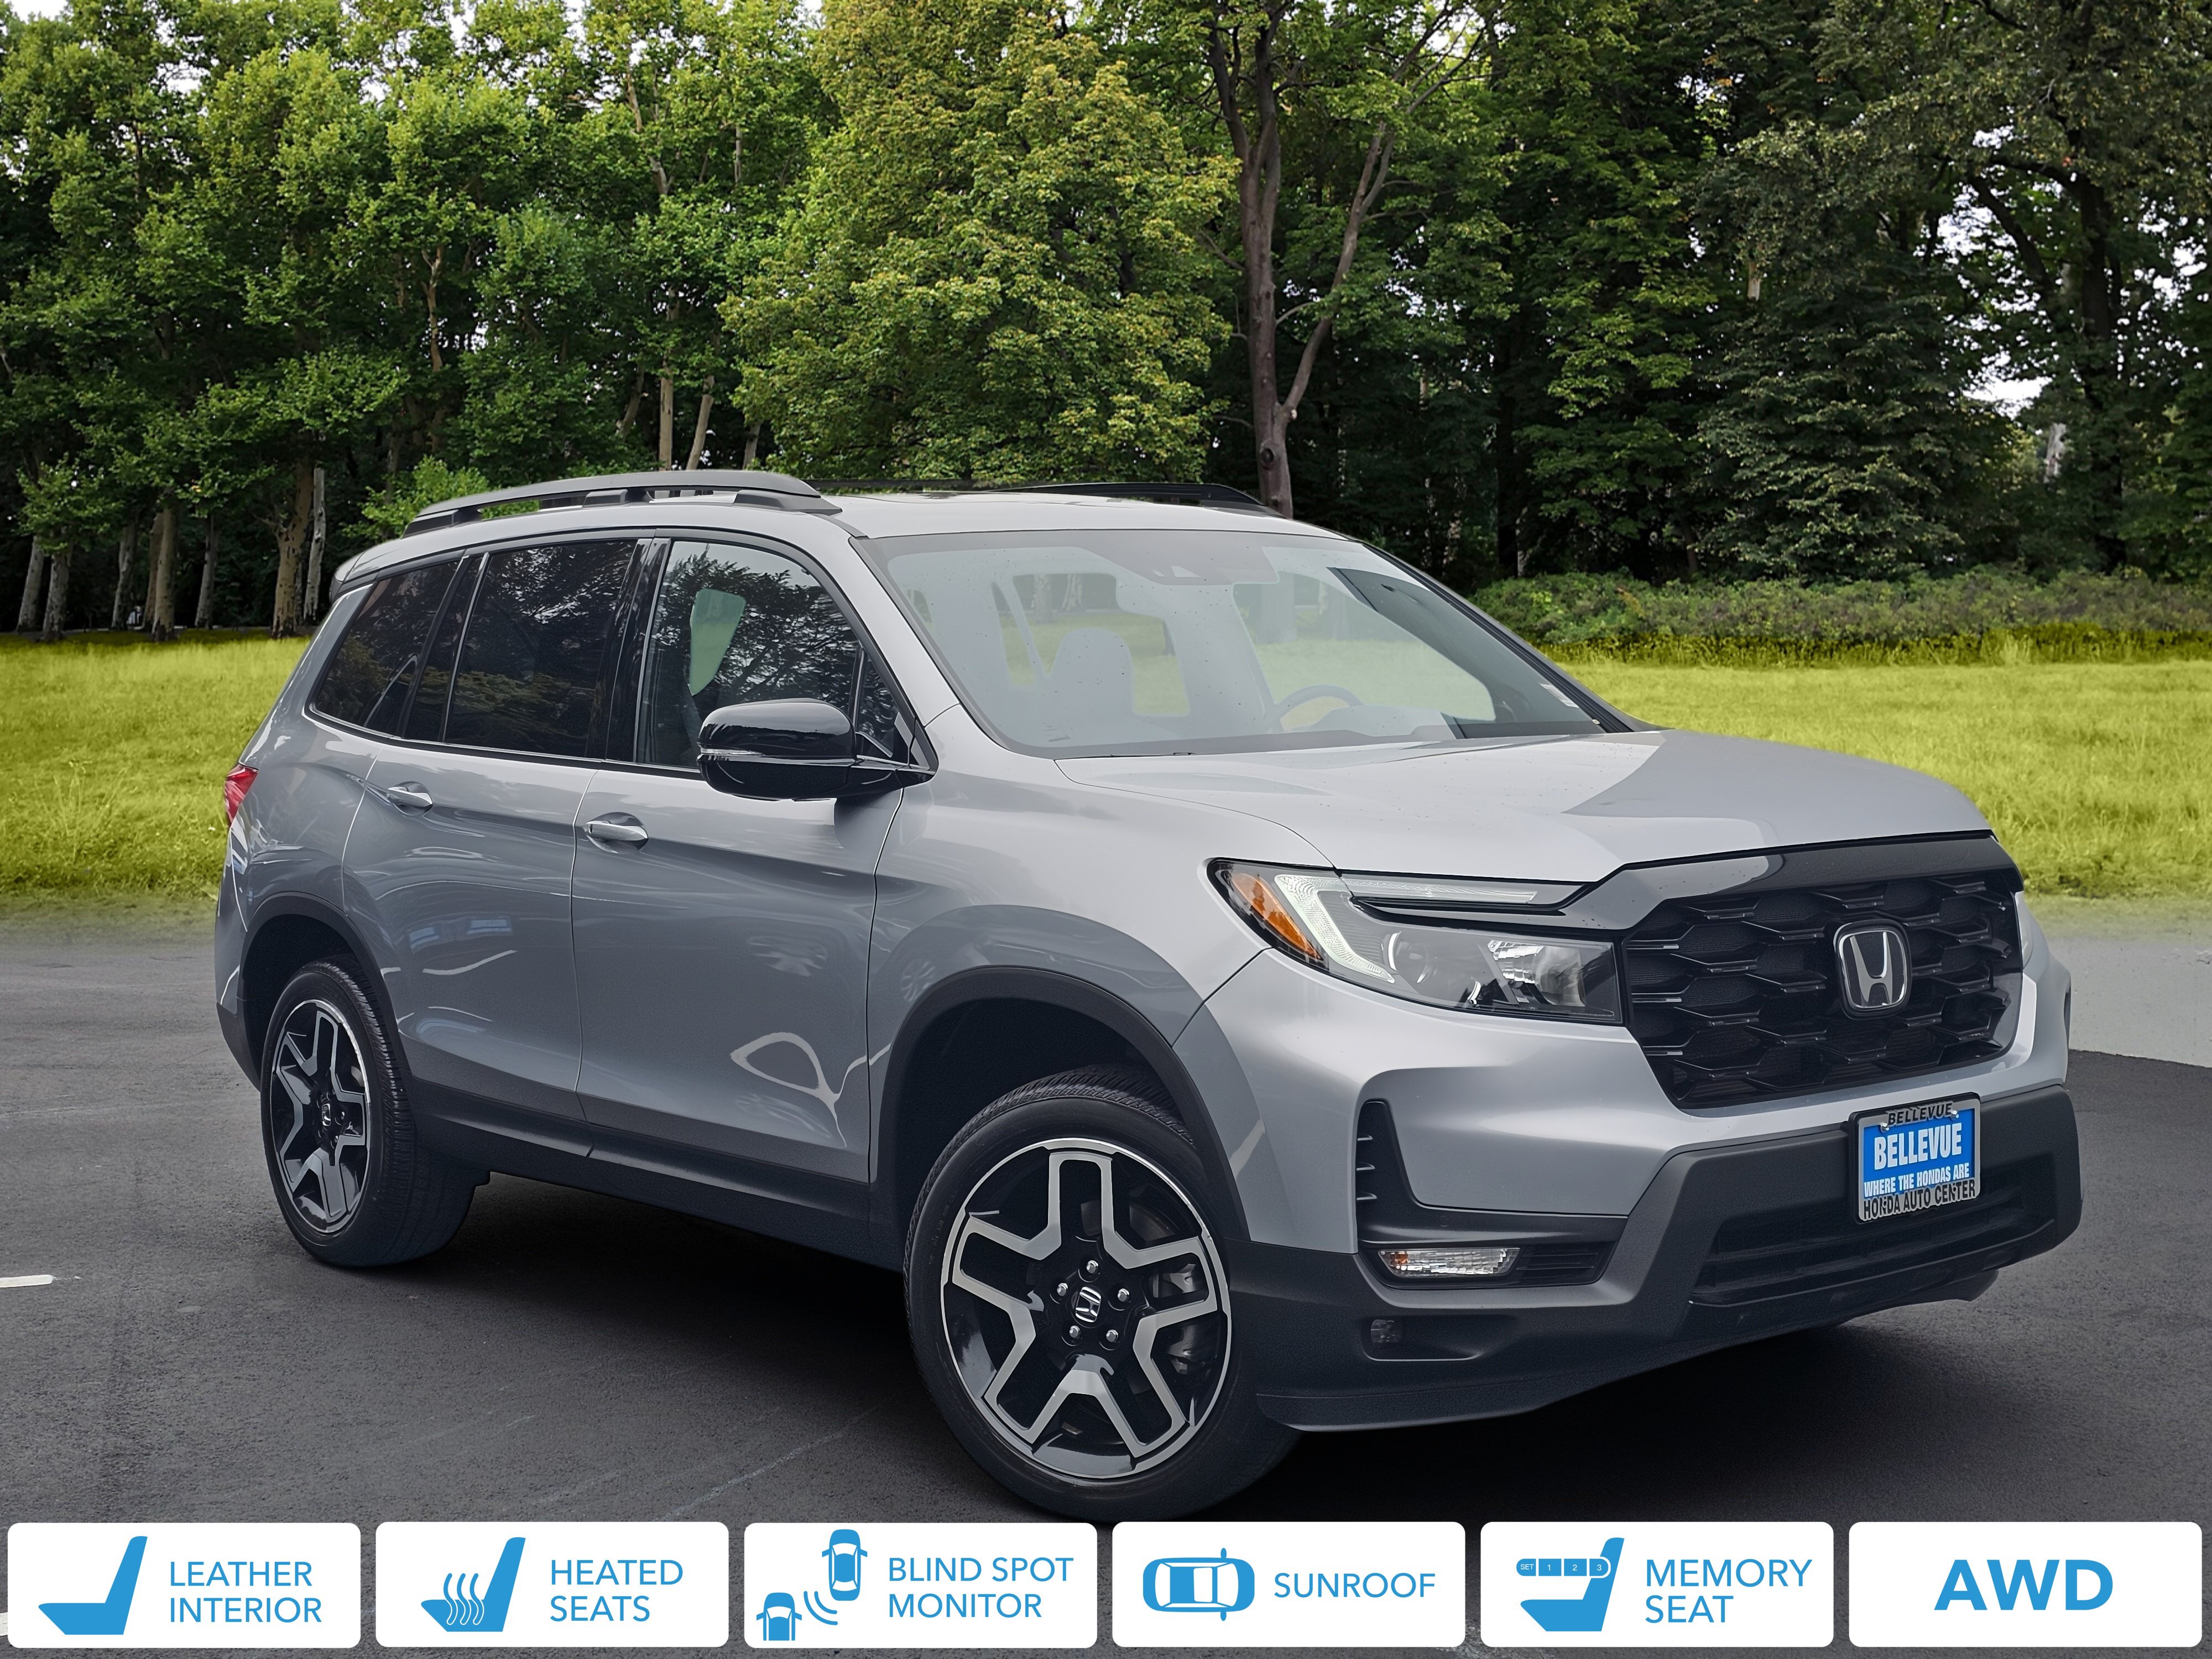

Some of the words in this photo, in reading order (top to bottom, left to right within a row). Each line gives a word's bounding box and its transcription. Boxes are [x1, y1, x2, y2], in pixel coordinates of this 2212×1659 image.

[1888, 1103, 1953, 1125] BELLEVUE
[1874, 1123, 1962, 1170] BELLEVUE
[1864, 1177, 1896, 1198] WHERE
[1898, 1173, 1914, 1191] THE
[1917, 1166, 1951, 1187] HONDAS
[1953, 1162, 1969, 1180] ARE
[1903, 1187, 1931, 1211] AUTO
[1935, 1180, 1975, 1204] CENTER
